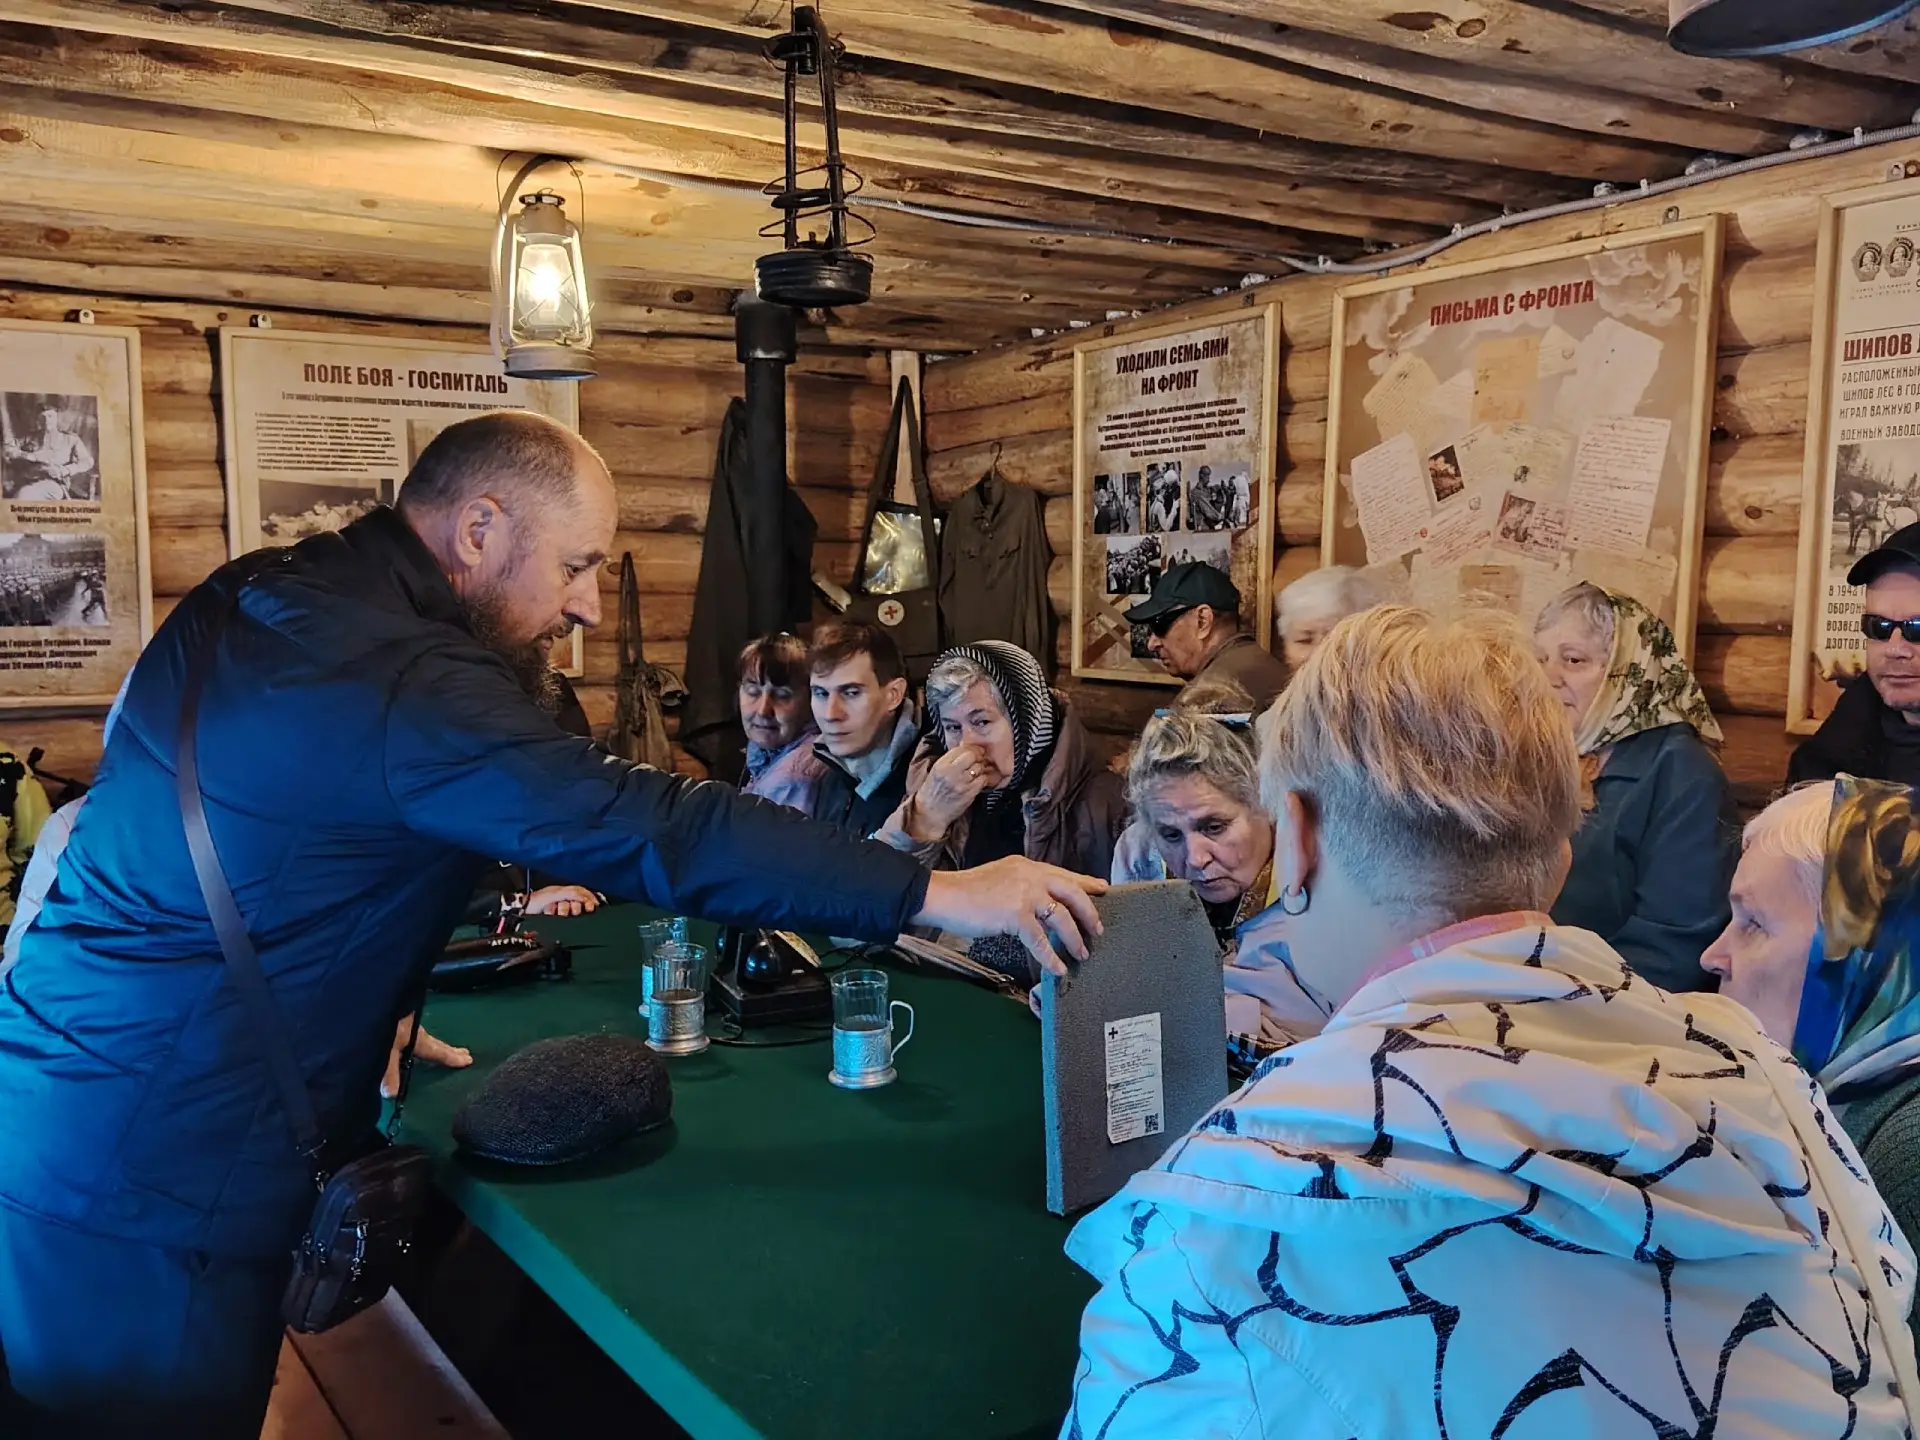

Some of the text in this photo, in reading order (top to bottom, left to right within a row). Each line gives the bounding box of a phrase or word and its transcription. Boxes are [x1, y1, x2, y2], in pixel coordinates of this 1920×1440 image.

[1430, 279, 1594, 327] ПИСЬМА С ФРОНТА
[1116, 336, 1229, 375] УХОДИЛИ СЕМЬЯМИ
[1843, 333, 1912, 362] ШИПОВ
[303, 363, 352, 385] ПОЛЕ
[357, 367, 393, 387] БОЯ
[408, 370, 509, 394] ГОСПИТАЛЬ
[1141, 369, 1199, 396] НА ФРОНТ
[1843, 388, 1874, 402] ШИПОВ
[1876, 385, 1894, 399] ЛЕС
[1897, 384, 1903, 397] В
[1839, 406, 1867, 419] ИГРАЛ
[1870, 402, 1912, 418] ВАЖНУЮ
[1840, 426, 1883, 441] ВОЕННЫХ
[1826, 620, 1860, 633] ВОЗВЕД
[1825, 637, 1860, 650] ДЗОТОВ
